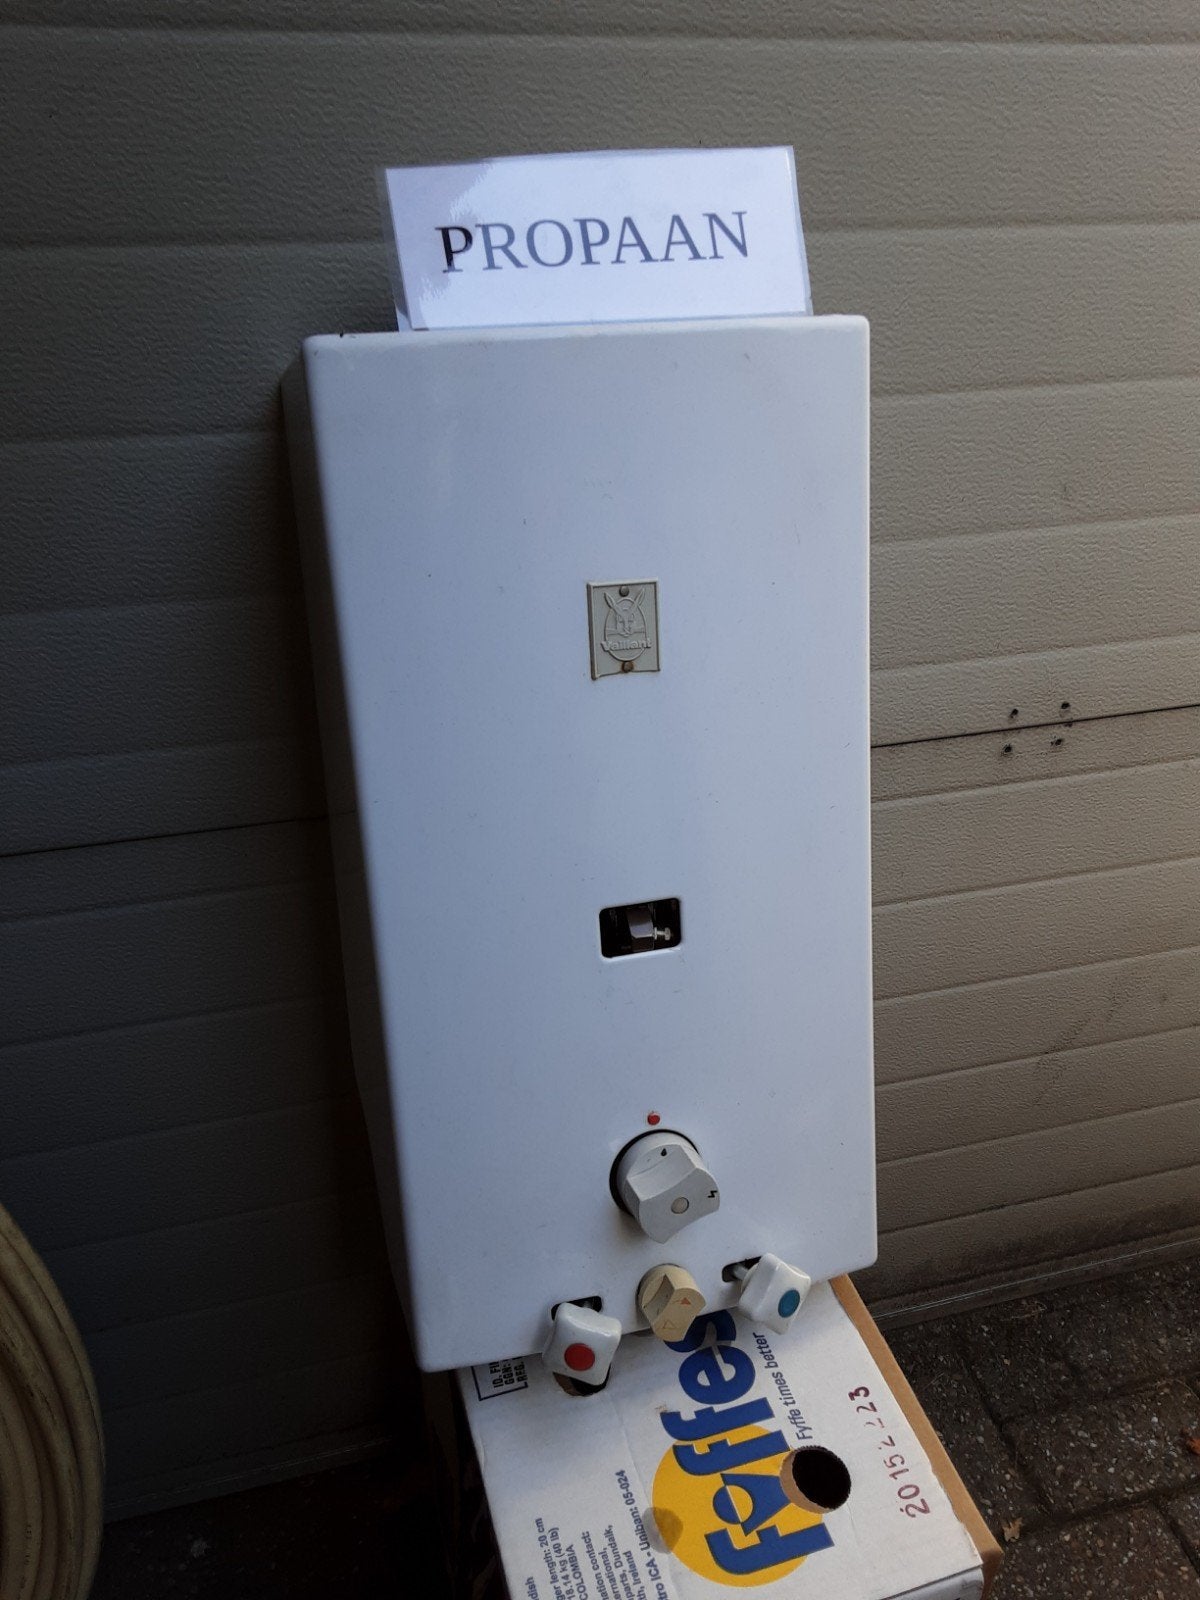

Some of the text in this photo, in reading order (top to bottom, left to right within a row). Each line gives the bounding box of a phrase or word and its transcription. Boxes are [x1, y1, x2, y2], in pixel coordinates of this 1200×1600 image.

[435, 210, 749, 273] PROPAAN
[753, 1332, 813, 1441] Fyffe times better
[615, 1470, 635, 1506] 05-024
[535, 1518, 545, 1533] cm
[538, 1535, 548, 1548] 20
[548, 1527, 559, 1541] lb)
[630, 1507, 650, 1551] Uniban:
[581, 1531, 600, 1571] contact:
[604, 1525, 623, 1568] Dundalk,
[544, 1549, 559, 1584] length:
[559, 1559, 568, 1573] kg
[566, 1544, 588, 1600] COLOMBIA
[622, 1551, 641, 1585] Ireland
[646, 1558, 661, 1581] ICA
